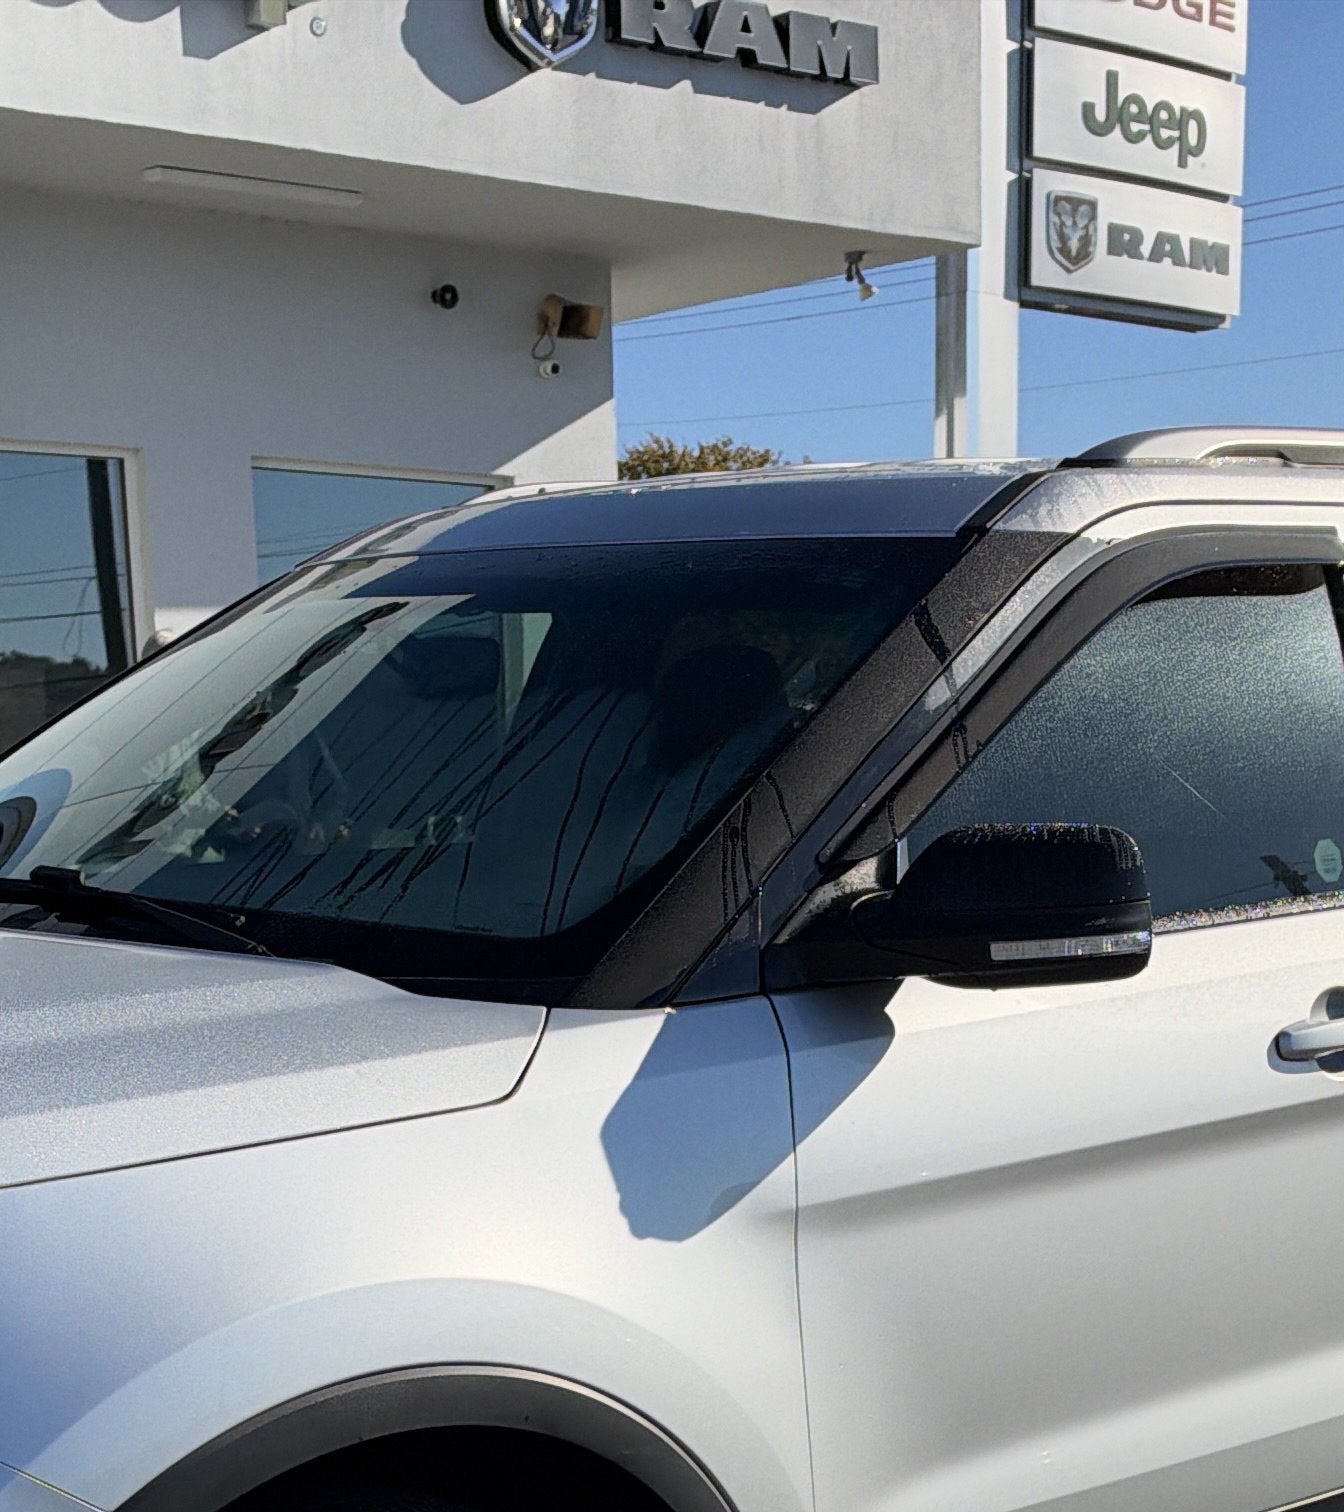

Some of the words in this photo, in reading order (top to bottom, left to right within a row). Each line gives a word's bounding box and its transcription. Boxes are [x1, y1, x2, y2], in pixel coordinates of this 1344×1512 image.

[608, 0, 879, 84] RAM
[1081, 69, 1207, 169] Jeep
[1107, 222, 1231, 276] RAM
